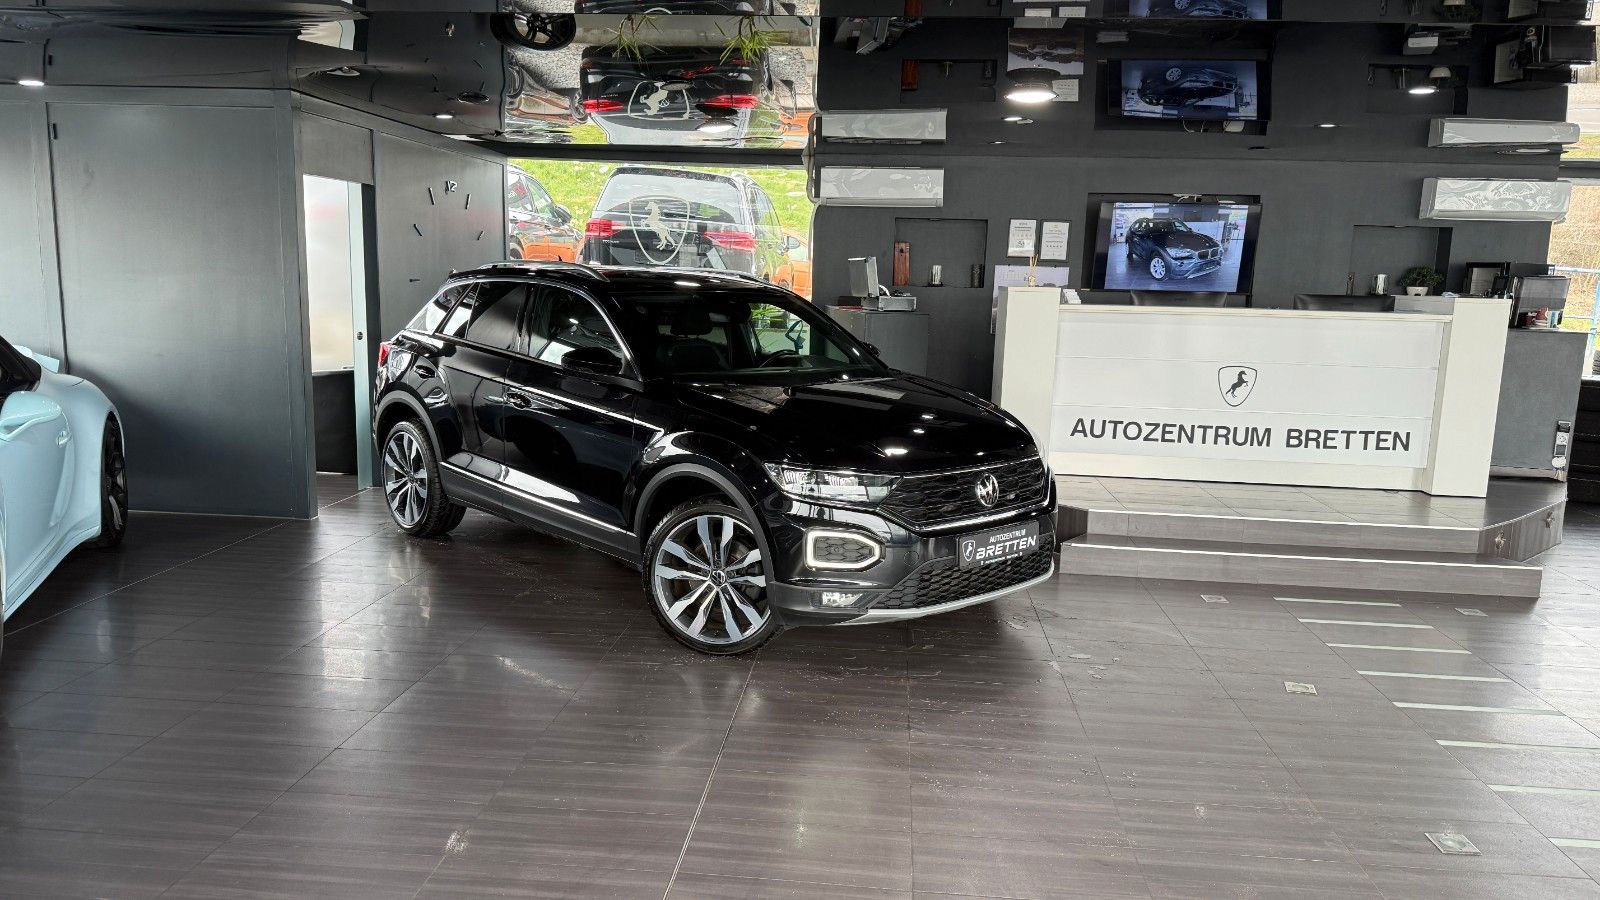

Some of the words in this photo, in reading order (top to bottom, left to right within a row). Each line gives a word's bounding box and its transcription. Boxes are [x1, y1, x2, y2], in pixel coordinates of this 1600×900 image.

[445, 180, 458, 193] 12
[1070, 417, 1272, 448] AUTOZENTRUM
[1285, 428, 1412, 452] BRETTEN
[989, 528, 1026, 543] AUTOZENTRUM
[976, 535, 1037, 560] BRETTEN
